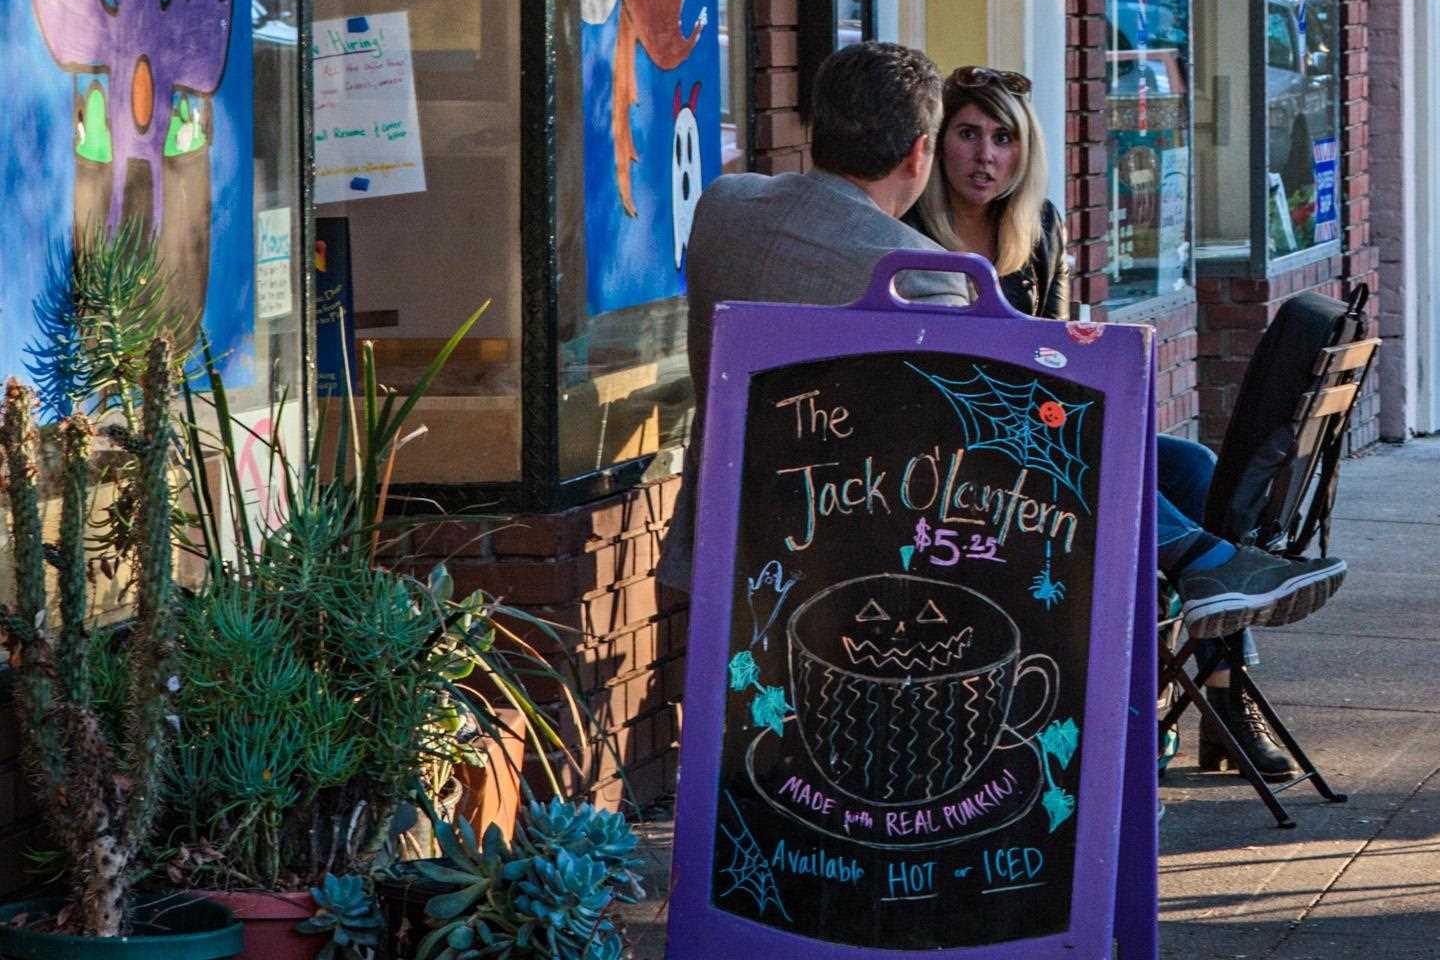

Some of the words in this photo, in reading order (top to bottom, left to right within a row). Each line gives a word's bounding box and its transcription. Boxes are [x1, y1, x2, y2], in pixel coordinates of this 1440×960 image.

[776, 389, 854, 441] The
[776, 456, 891, 551] Jack
[778, 775, 837, 815] MADE
[885, 809, 941, 837] REAL
[771, 839, 865, 886] Available
[888, 860, 938, 898] HOT
[983, 847, 1044, 885] ICED
